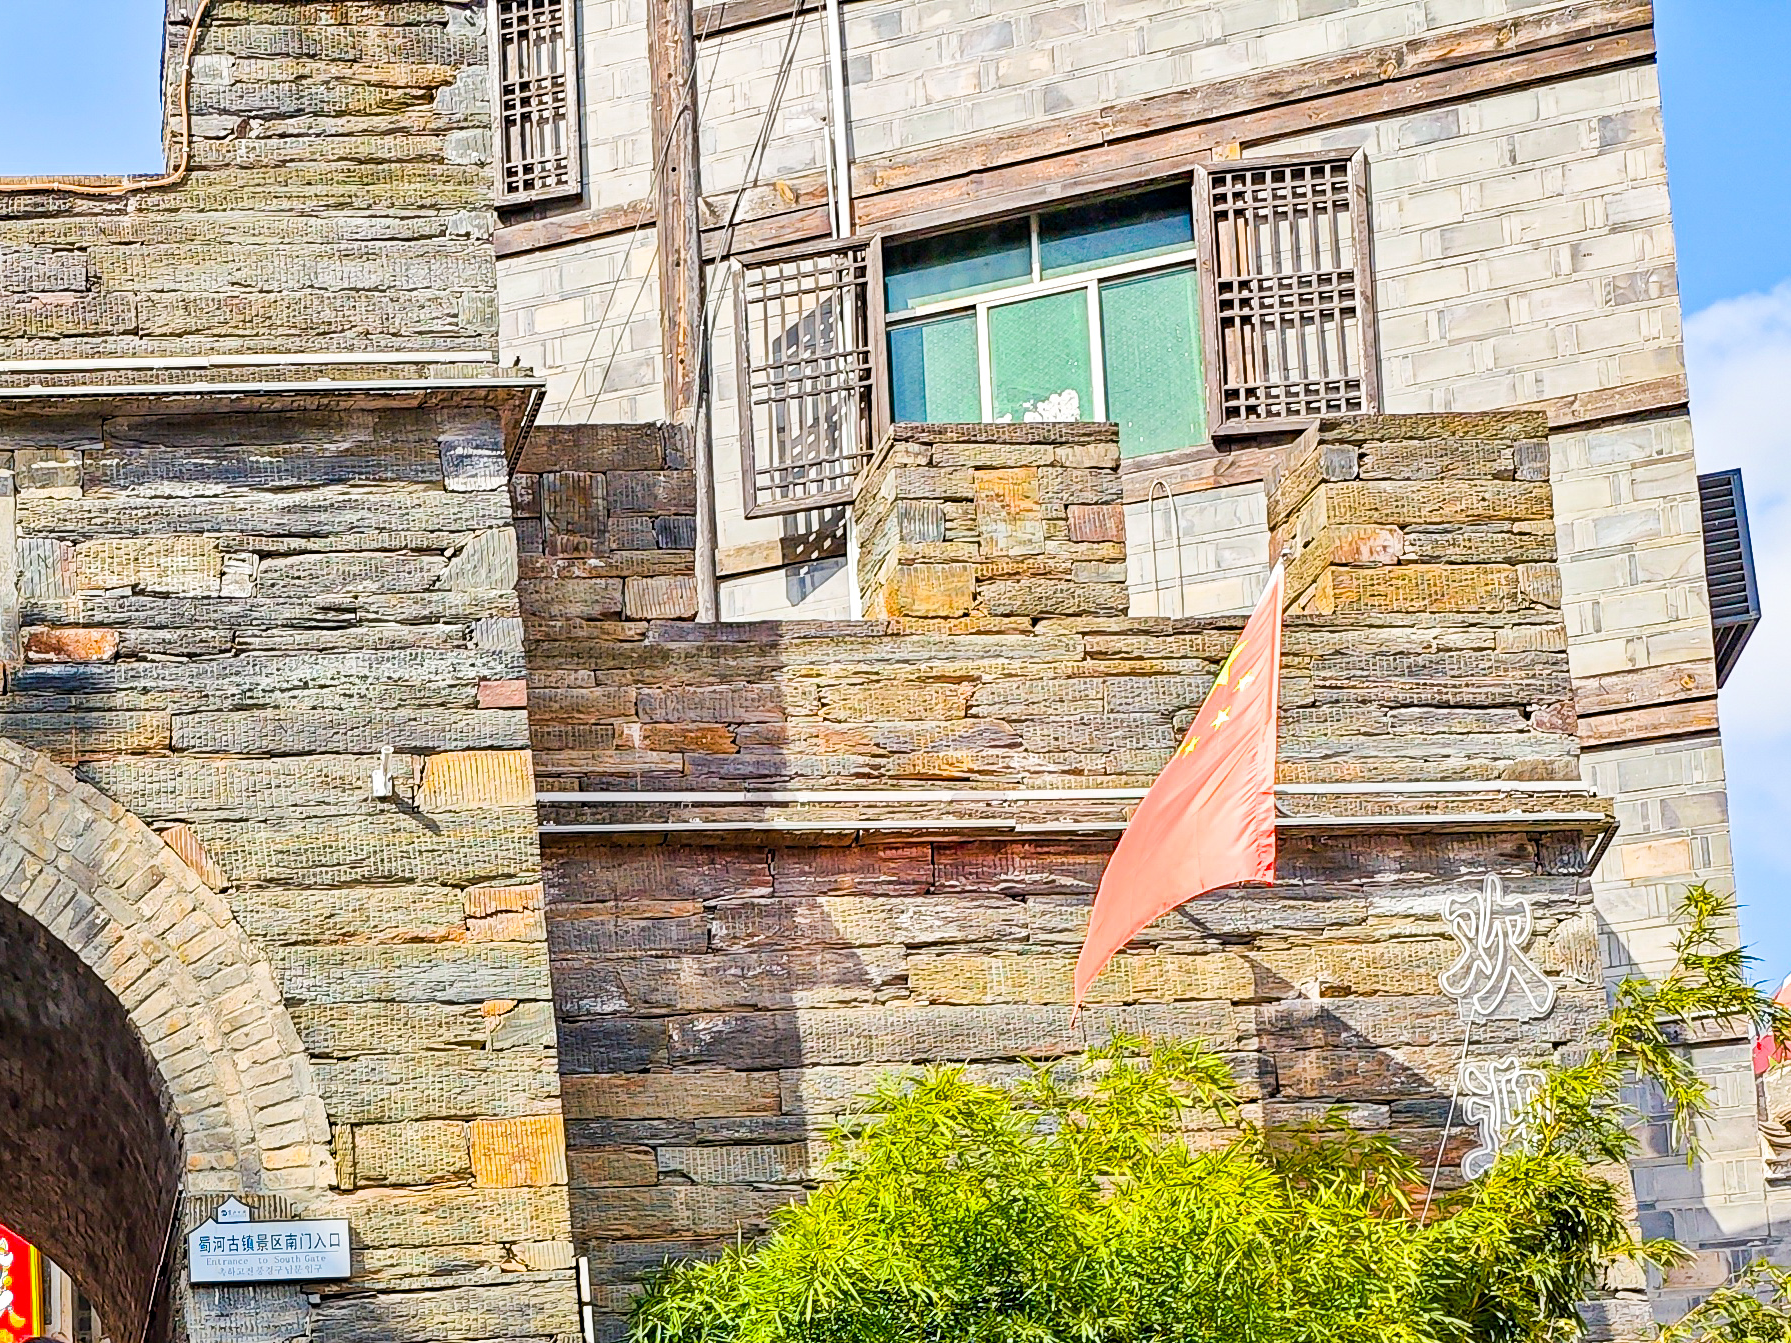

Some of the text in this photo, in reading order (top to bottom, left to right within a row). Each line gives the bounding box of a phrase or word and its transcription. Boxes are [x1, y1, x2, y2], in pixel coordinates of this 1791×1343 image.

[198, 1232, 341, 1253] 蜀河古镇景区南门入口
[206, 1254, 326, 1266] Entrance to South Gate
